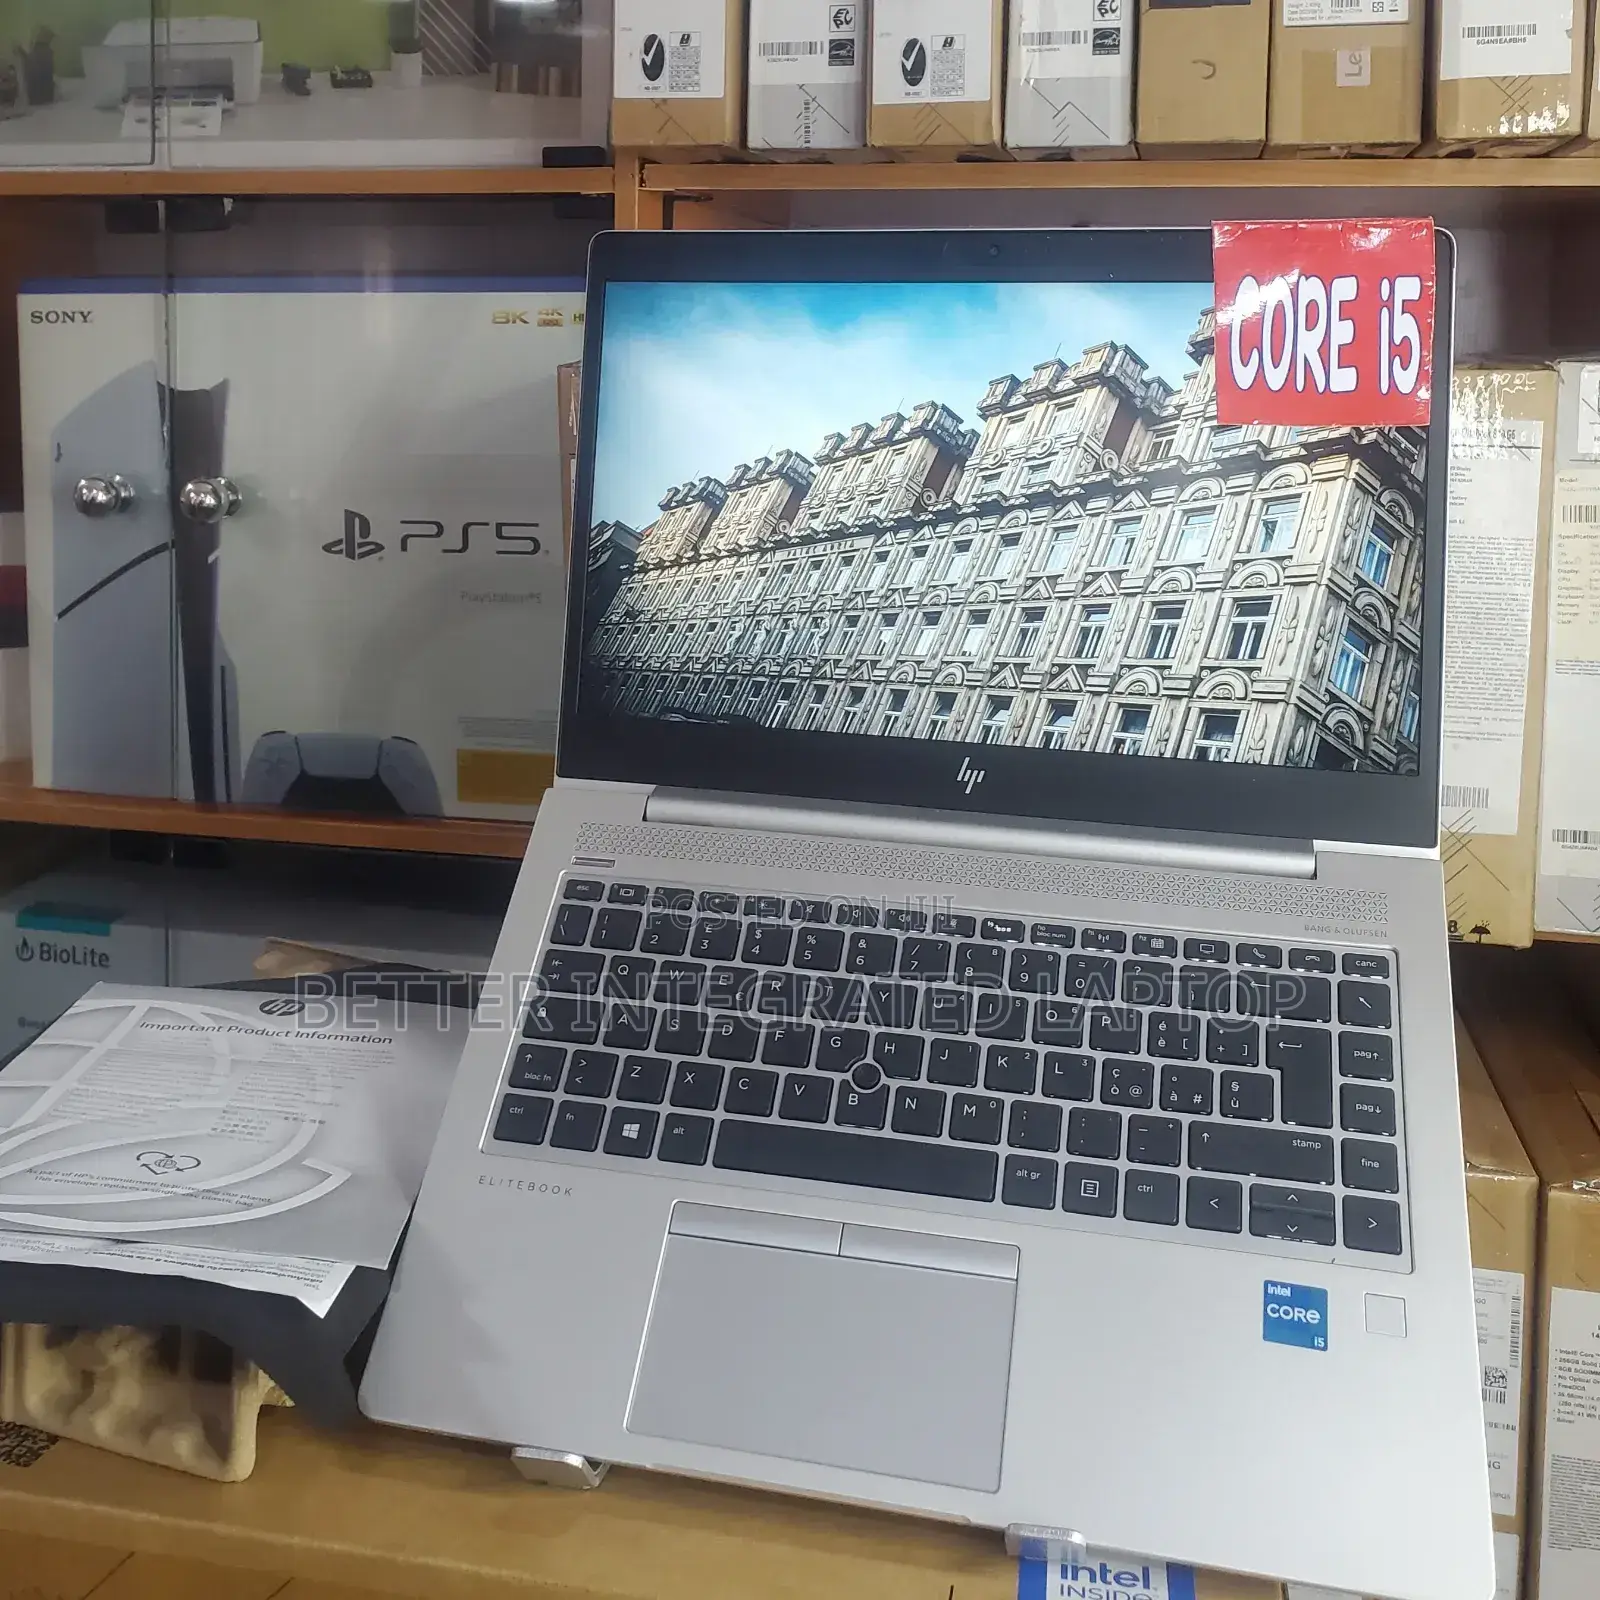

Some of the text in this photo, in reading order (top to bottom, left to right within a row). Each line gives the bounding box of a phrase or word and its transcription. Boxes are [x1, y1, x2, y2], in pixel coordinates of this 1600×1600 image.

[30, 310, 93, 324] SONY
[492, 310, 529, 324] 8K
[1230, 275, 1421, 395] CORE i5
[401, 520, 541, 555] PS5
[1304, 924, 1331, 934] BANG
[1343, 928, 1388, 938] OLUFSEN
[40, 942, 109, 968] BioLite
[1355, 960, 1377, 968] canc
[140, 1021, 393, 1044] Important Product Information
[1354, 1050, 1371, 1059] pag
[524, 1071, 552, 1082] bloc fn
[509, 1106, 523, 1115] ctrl
[1355, 1102, 1374, 1113] pag
[566, 1112, 575, 1121] fn
[673, 1126, 685, 1134] alt
[1292, 1138, 1322, 1150] stamp
[1361, 1158, 1380, 1168] fine
[1016, 1169, 1041, 1180] alt gr
[478, 1175, 573, 1197] ELITEBOOK
[1138, 1184, 1153, 1193] ctrl
[1314, 1336, 1325, 1347] i5
